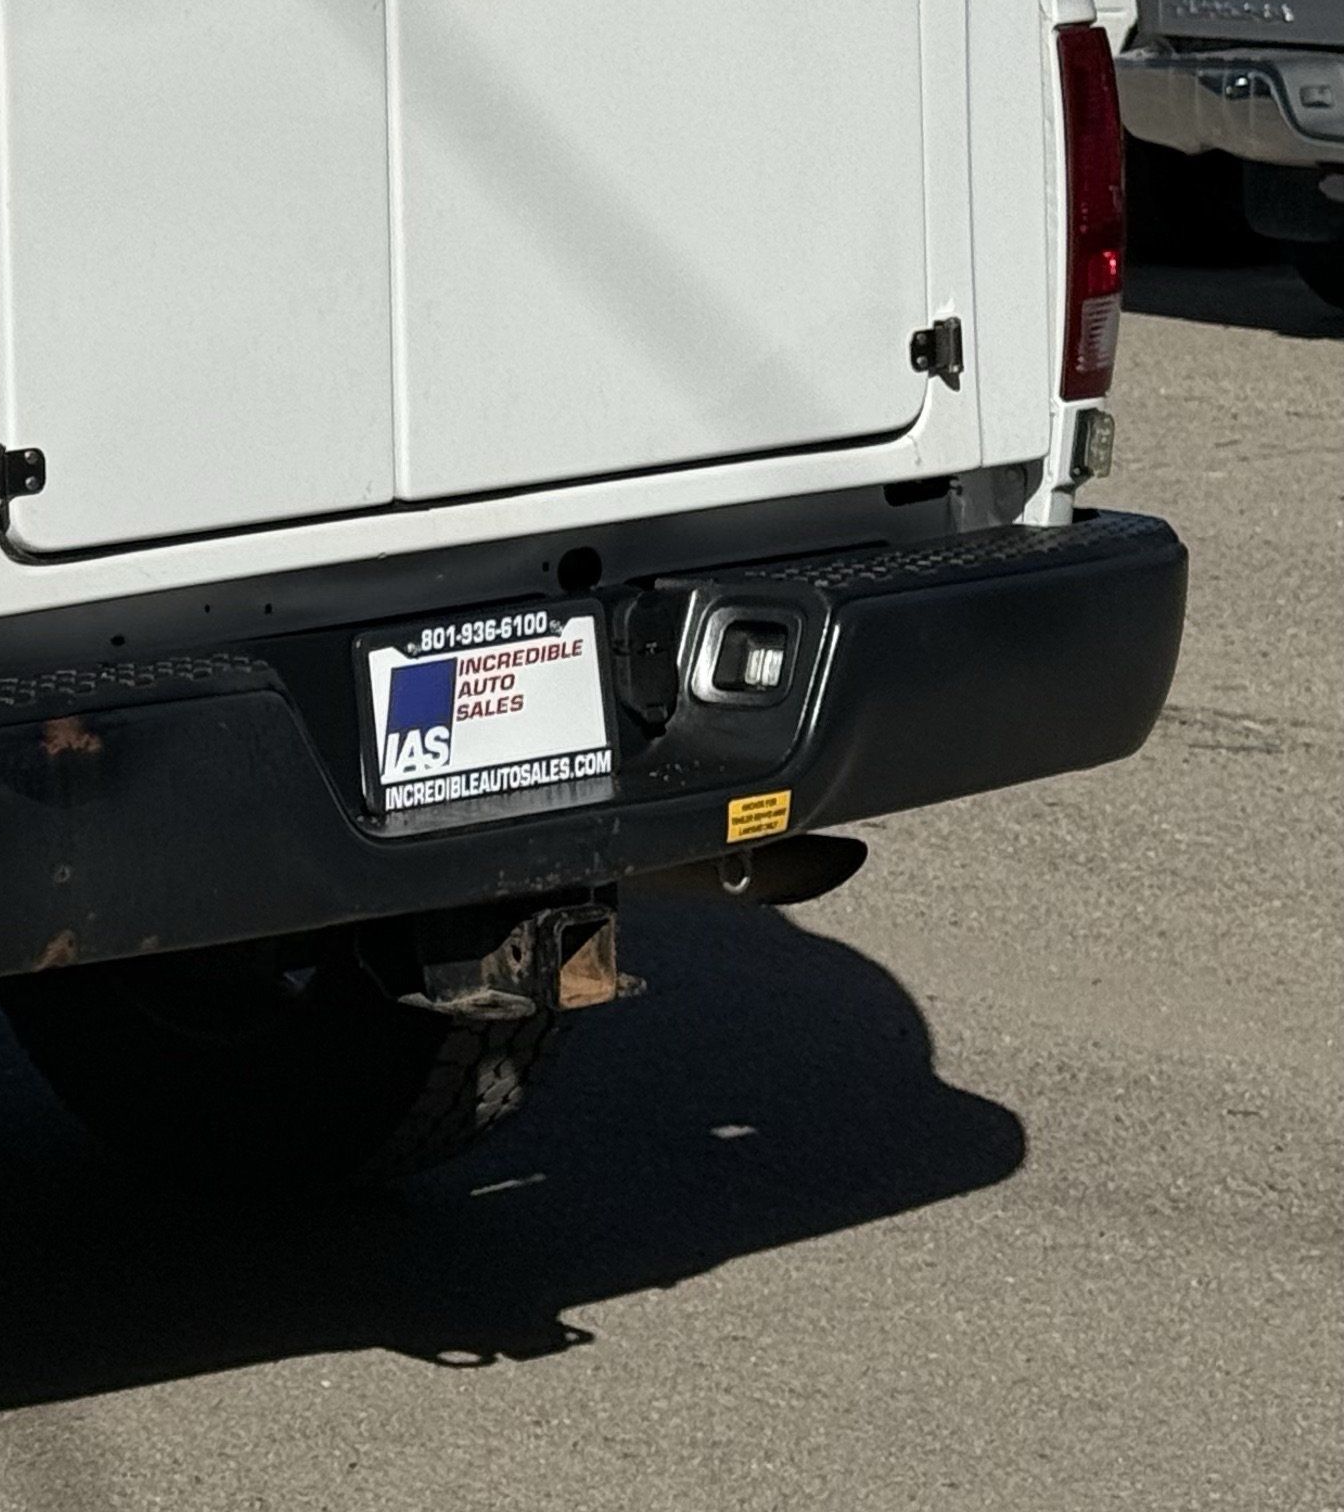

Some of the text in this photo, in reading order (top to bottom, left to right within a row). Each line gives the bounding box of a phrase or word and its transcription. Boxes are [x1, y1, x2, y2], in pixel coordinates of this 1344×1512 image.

[421, 611, 548, 651] 801-936-6100
[459, 639, 584, 677] INCREDIBLE
[457, 674, 516, 700] AUTO
[456, 694, 525, 723] SALES
[381, 725, 451, 780] IAS
[385, 750, 612, 811] INCREDIBLEAUTOSALES.COM
